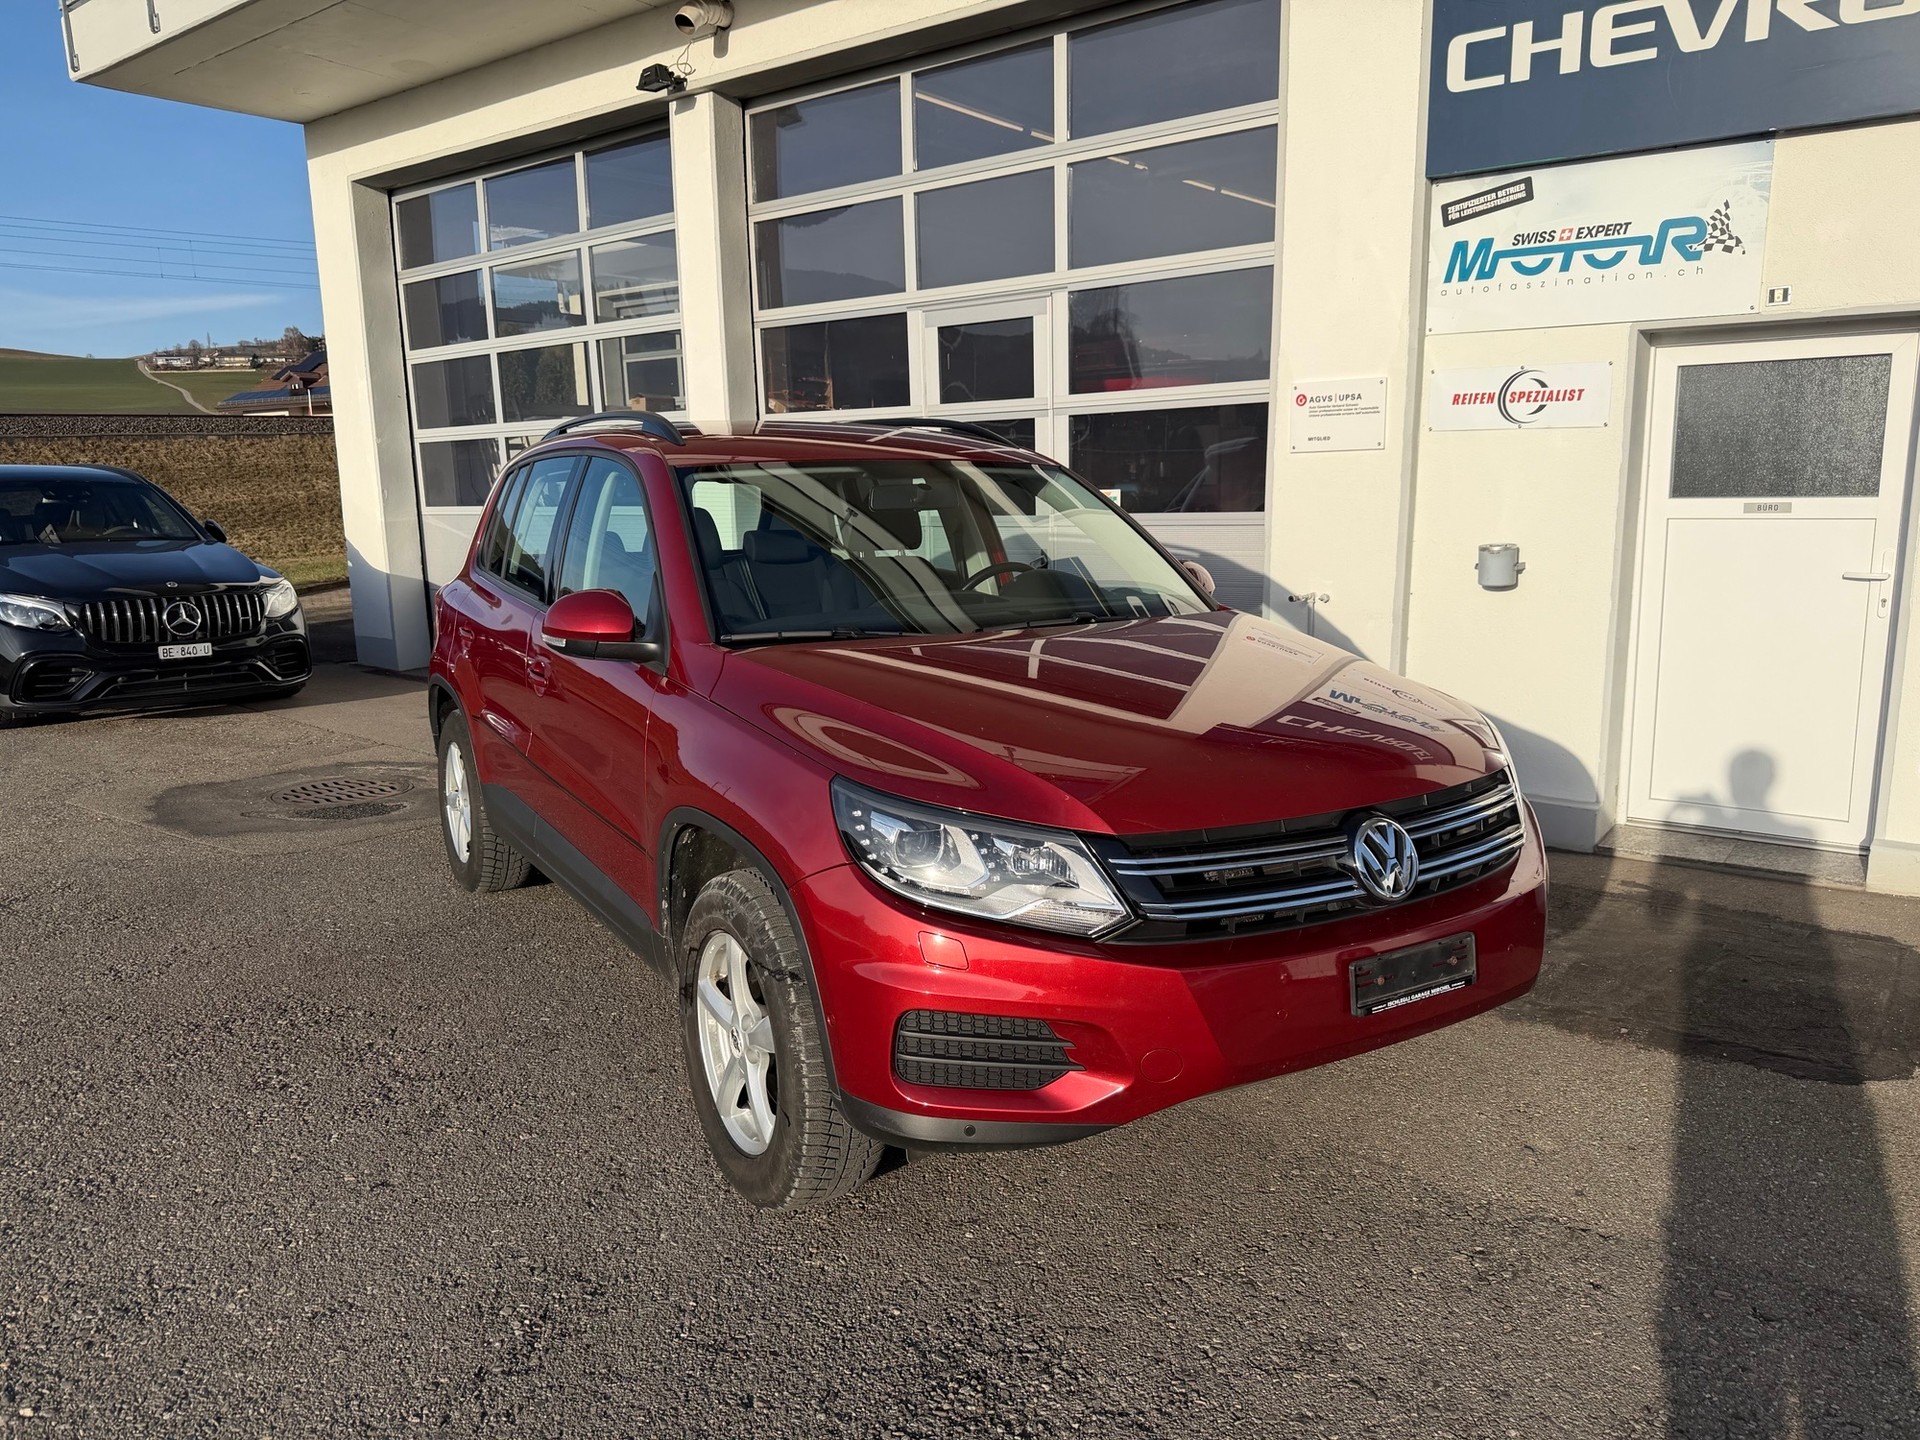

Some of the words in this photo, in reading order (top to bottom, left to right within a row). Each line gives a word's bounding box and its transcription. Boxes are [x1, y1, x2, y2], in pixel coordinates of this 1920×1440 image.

[1447, 192, 1497, 214] ZERTIFIZIERTER
[1497, 183, 1526, 198] BETRIEB
[1511, 229, 1557, 247] SWISS
[1575, 221, 1632, 240] EXPERT
[1309, 394, 1333, 404] AGVS
[1338, 393, 1362, 402] UPSA
[1452, 391, 1496, 406] REIFEN
[1508, 388, 1585, 404] SPEZIALIST
